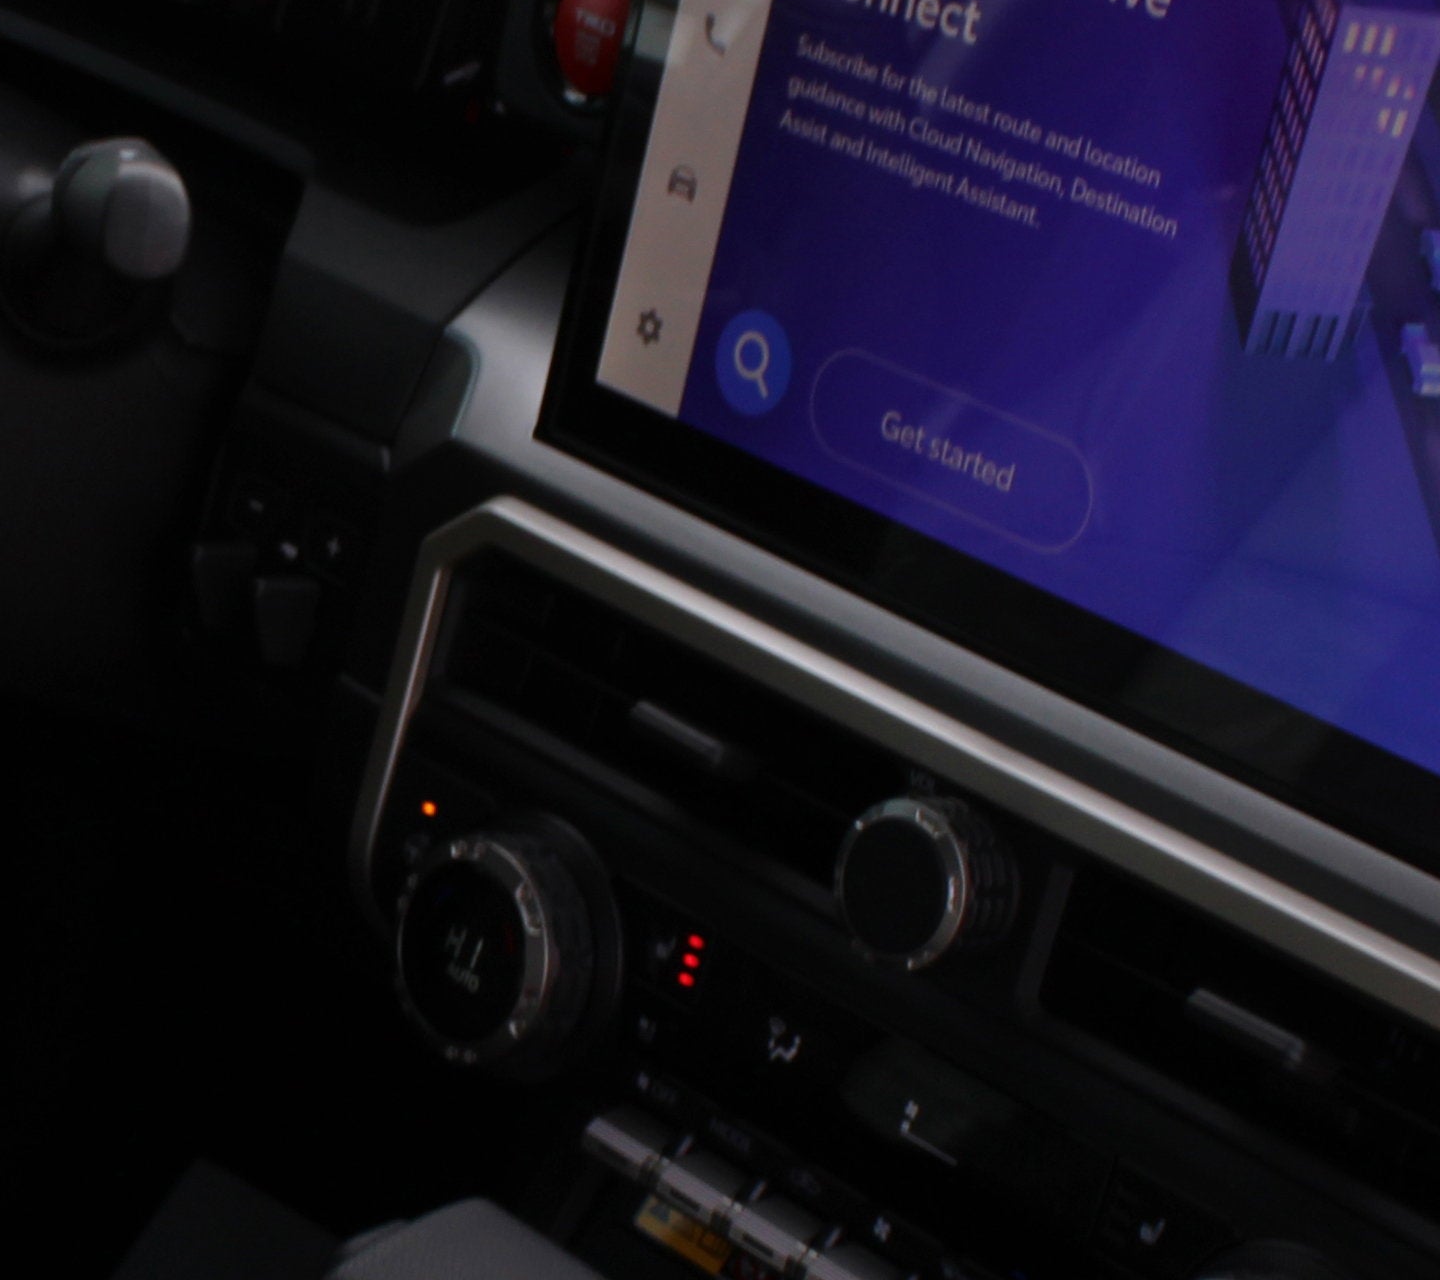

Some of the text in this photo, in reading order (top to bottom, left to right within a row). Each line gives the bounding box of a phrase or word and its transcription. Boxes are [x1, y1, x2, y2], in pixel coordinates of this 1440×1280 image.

[778, 106, 1041, 230] Assist and Intelligent Assistant.
[787, 74, 1179, 241] guidance with Cloud Navigation, Destination
[796, 32, 1162, 189] Subscribe for the latest route and location
[880, 410, 1017, 493] Get started
